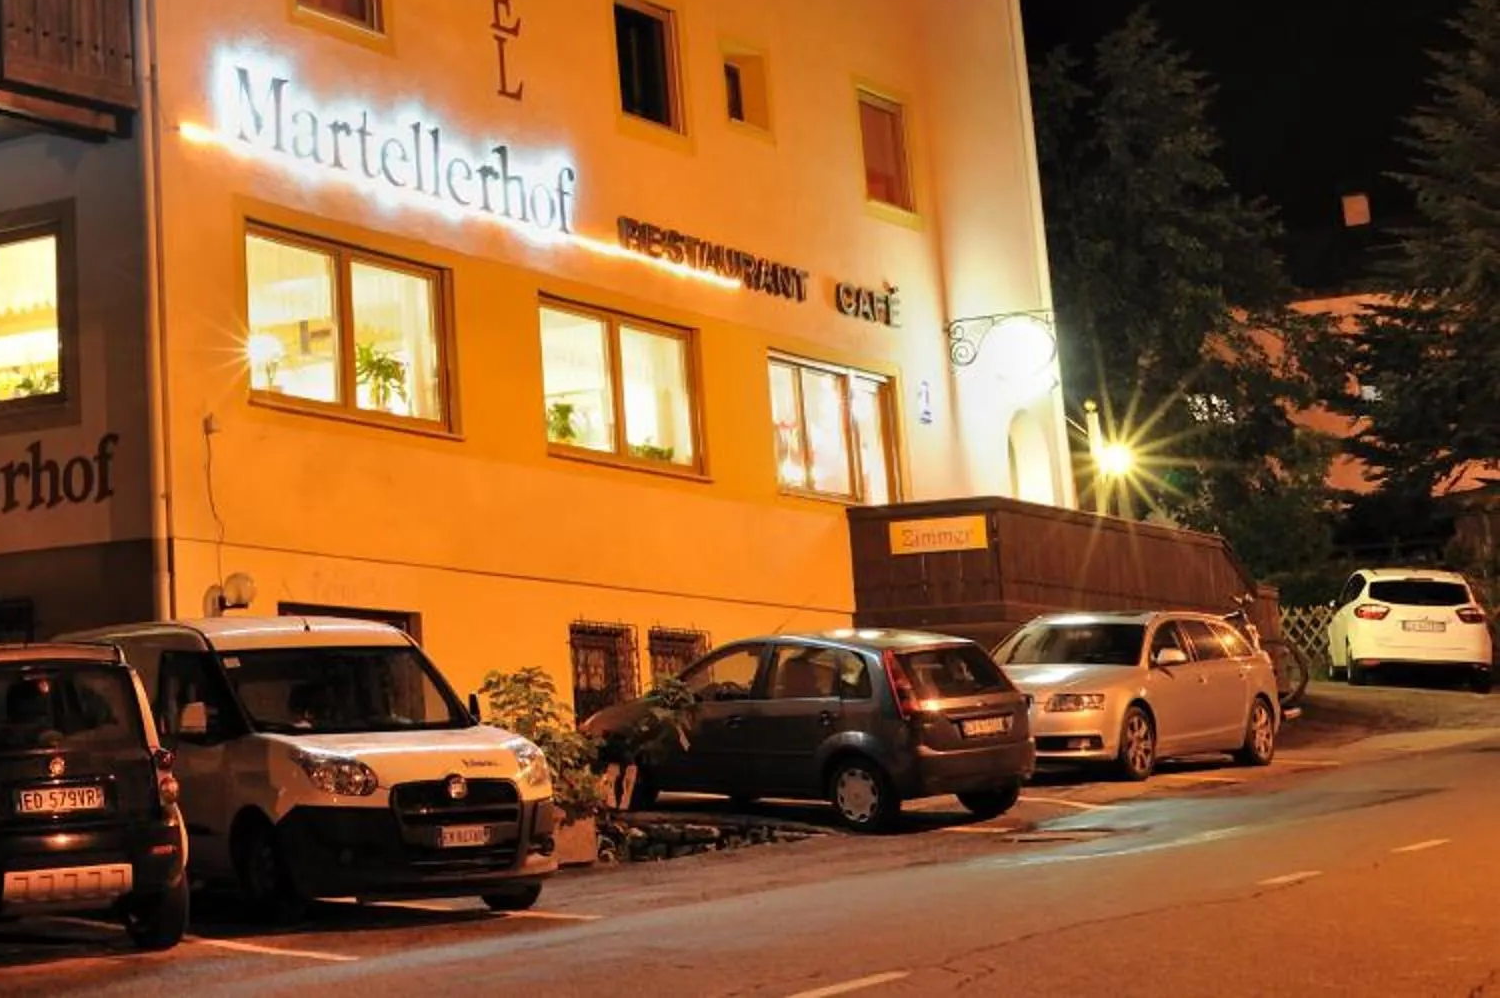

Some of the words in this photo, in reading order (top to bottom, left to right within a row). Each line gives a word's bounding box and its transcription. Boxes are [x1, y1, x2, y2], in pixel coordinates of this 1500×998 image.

[236, 66, 575, 234] Martellerhof
[617, 215, 808, 302] RESTAURANT
[835, 278, 901, 327] CAFÉ
[902, 528, 975, 548] Zimmer
